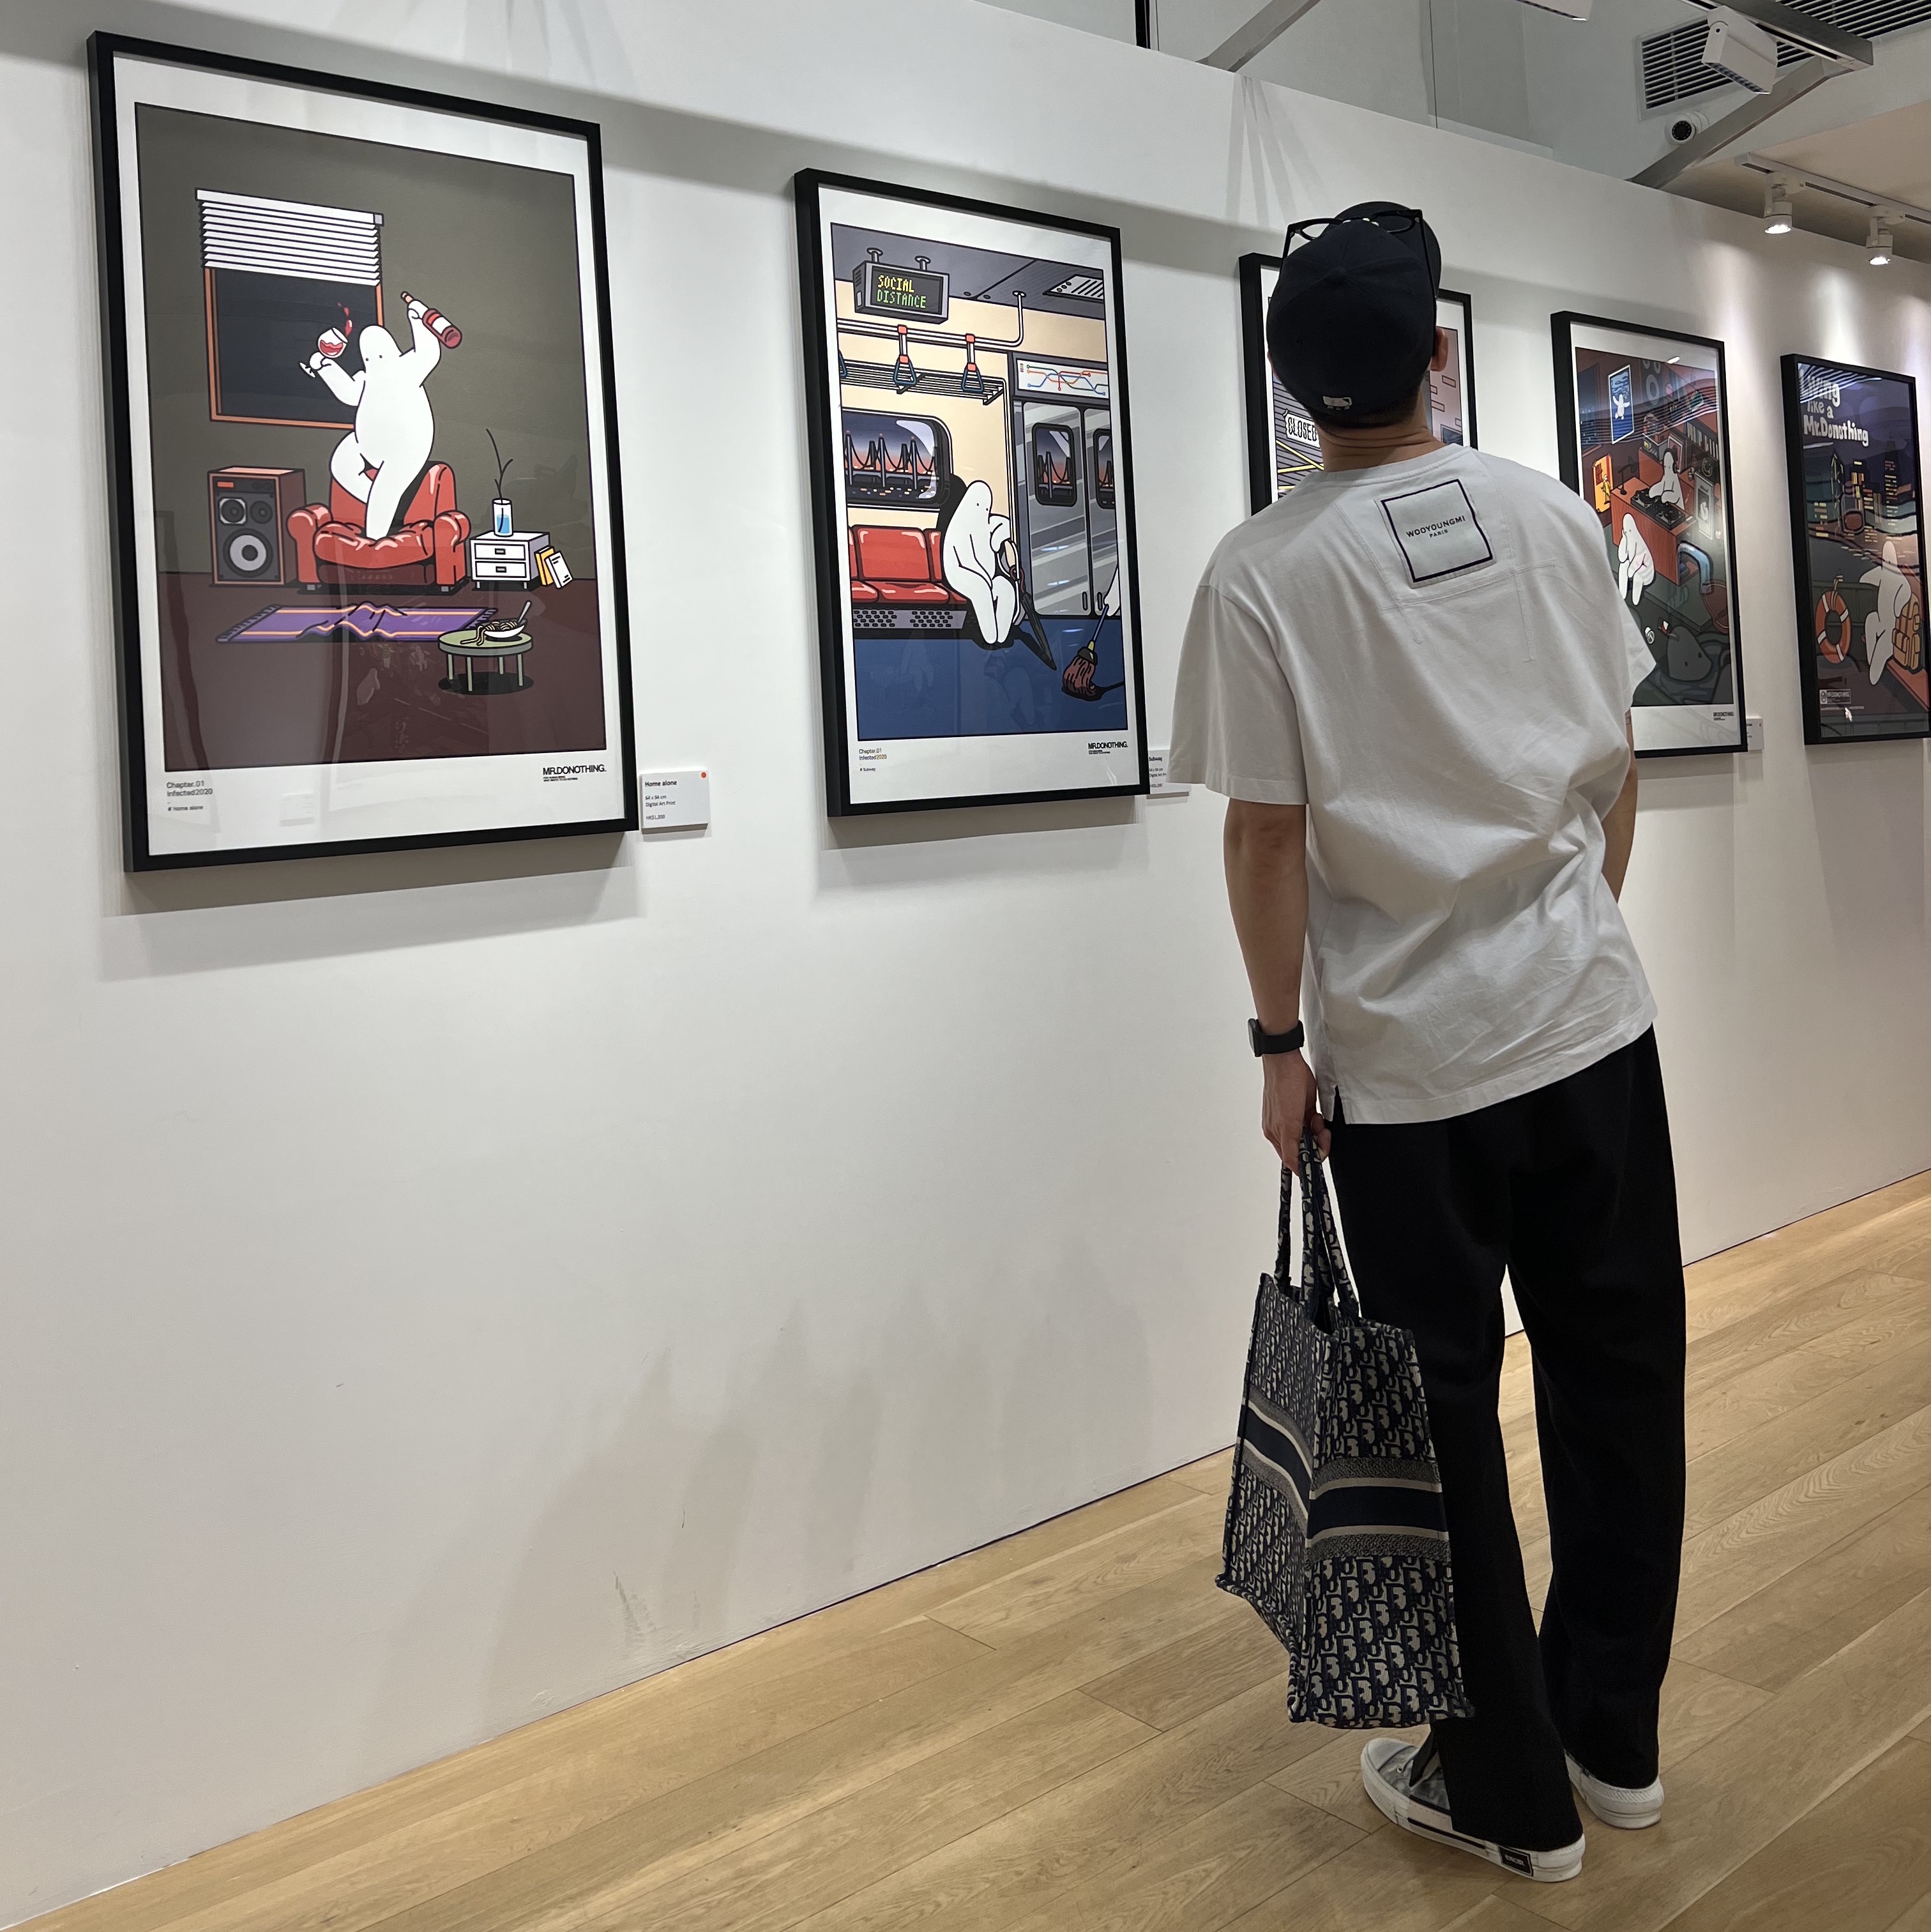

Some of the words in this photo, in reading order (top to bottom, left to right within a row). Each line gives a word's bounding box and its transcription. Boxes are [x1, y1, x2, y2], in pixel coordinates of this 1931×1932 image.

[877, 275, 914, 293] SOCIAL
[877, 289, 927, 308] DISTANCE
[1807, 400, 1825, 414] like
[1827, 406, 1834, 418] a
[1288, 416, 1317, 441] CLOSED
[1803, 415, 1869, 447] Mr.Donothing
[1406, 515, 1465, 537] WOOYOUNGMI
[1429, 529, 1448, 538] PARIS
